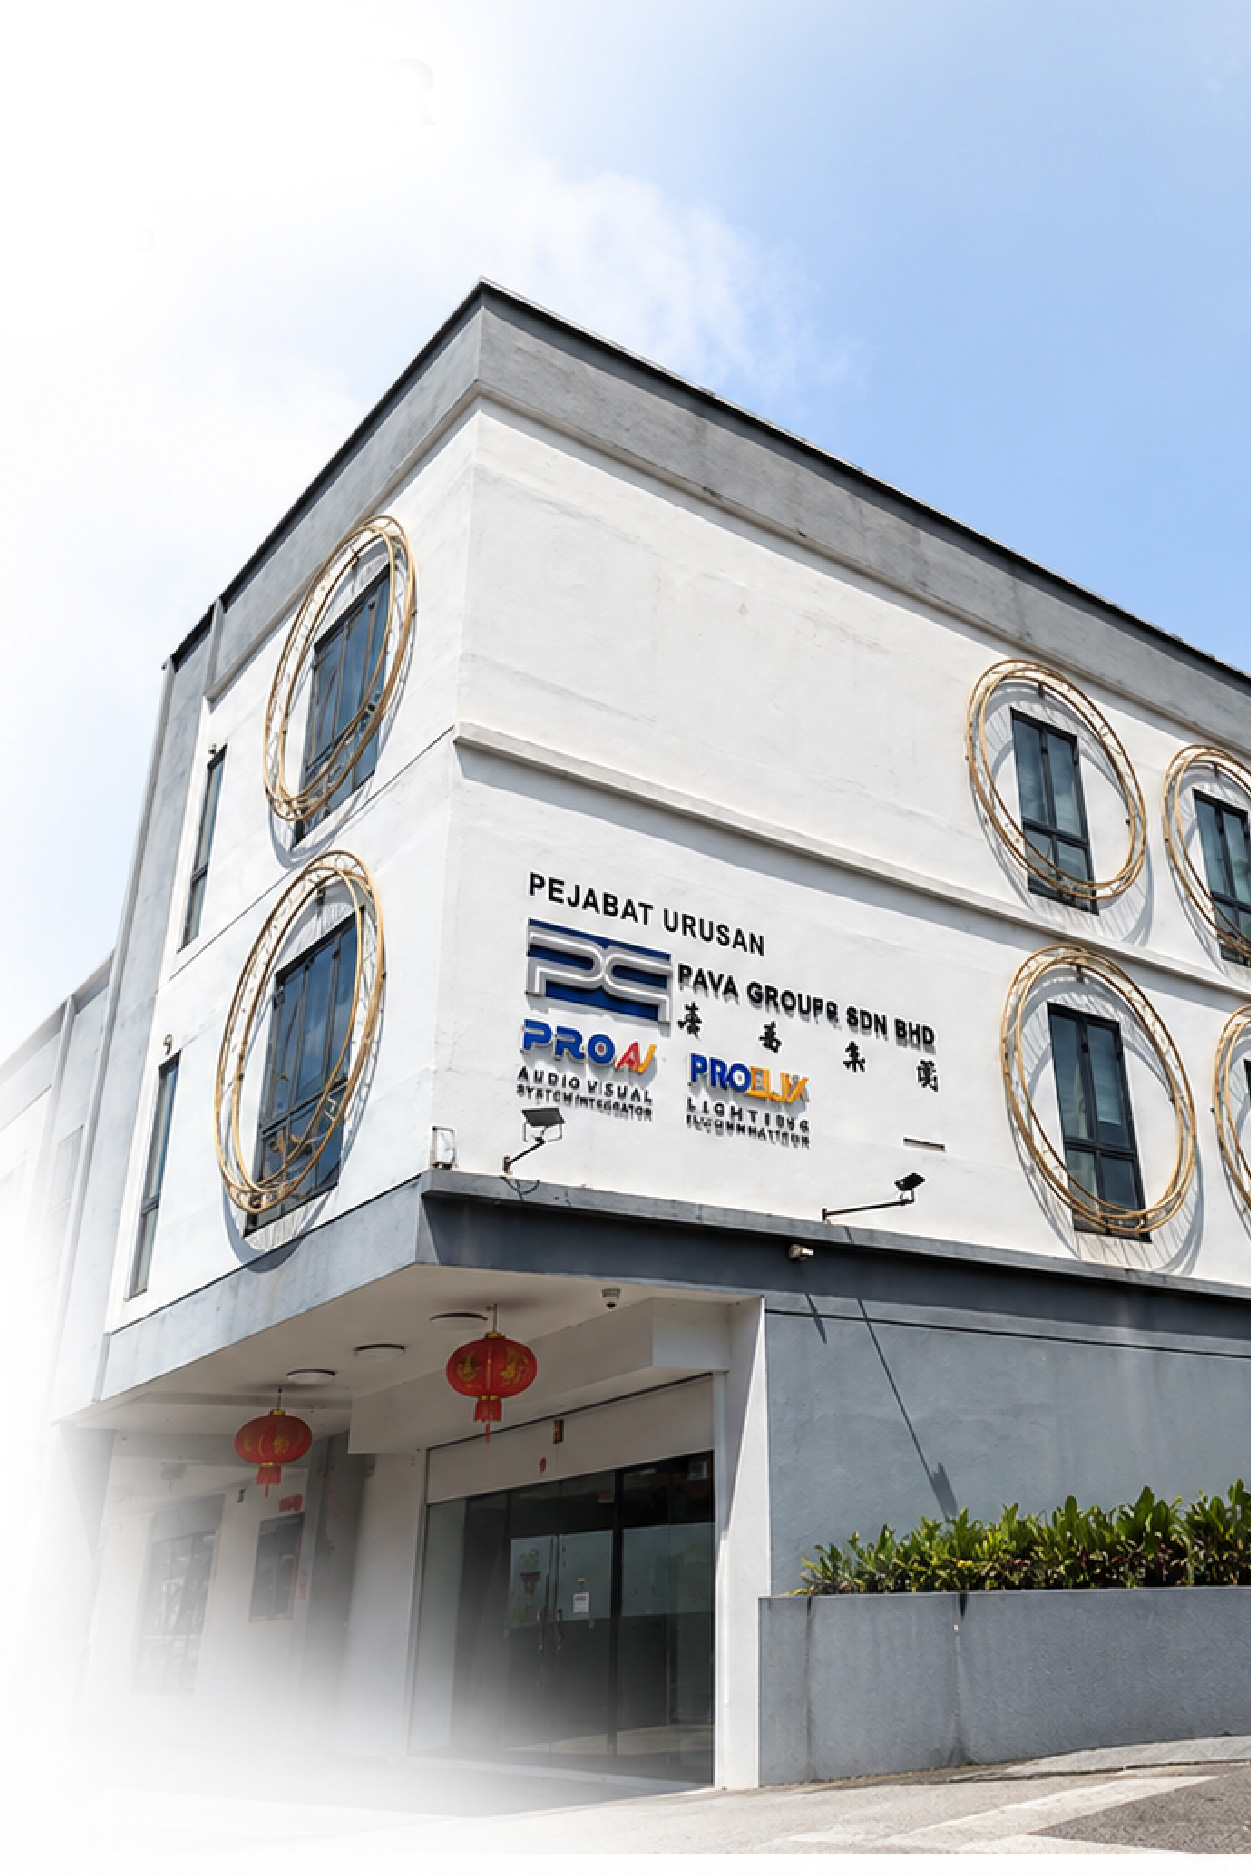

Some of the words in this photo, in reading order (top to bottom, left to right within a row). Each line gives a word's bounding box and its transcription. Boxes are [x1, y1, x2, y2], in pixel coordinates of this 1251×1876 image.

[530, 872, 653, 925] PEJABAT
[664, 908, 764, 956] URUSAN
[678, 965, 738, 997] PAVA
[847, 1006, 887, 1034] SDN
[894, 1019, 934, 1048] BHD
[519, 1066, 579, 1090] AUDIO
[588, 1081, 651, 1104] VISUAL
